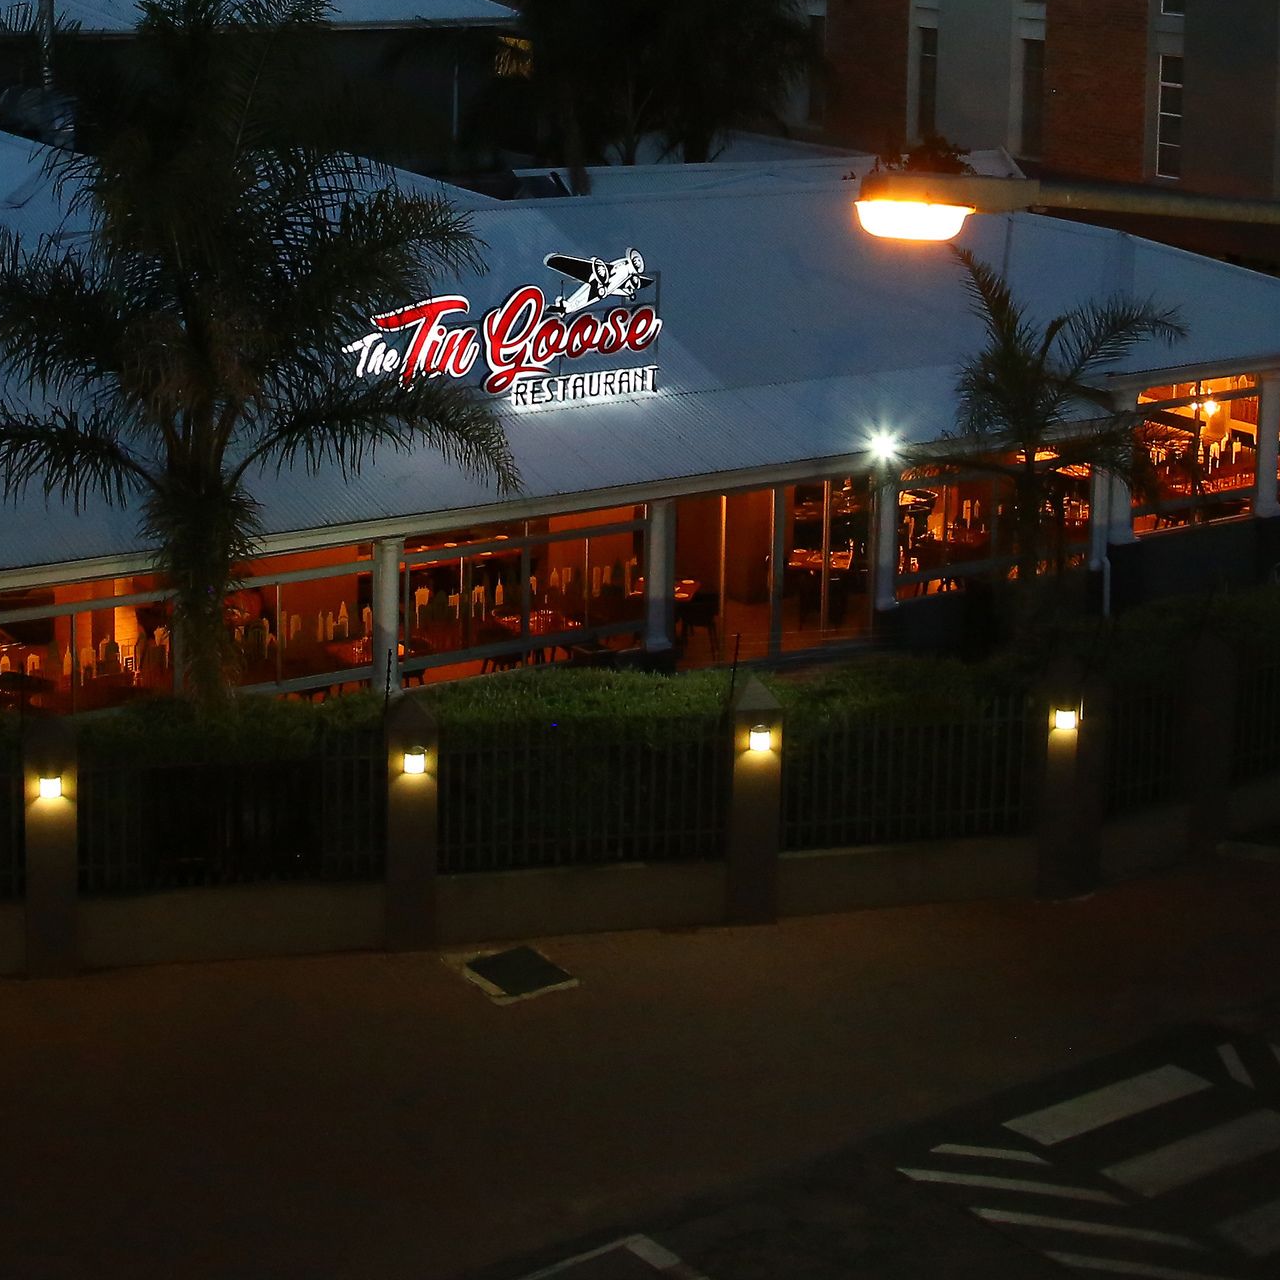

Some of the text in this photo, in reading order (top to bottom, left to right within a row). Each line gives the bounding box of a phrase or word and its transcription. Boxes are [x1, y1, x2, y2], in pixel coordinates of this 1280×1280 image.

[341, 285, 664, 394] The Tin Goose
[510, 365, 660, 407] RESTAURANT
